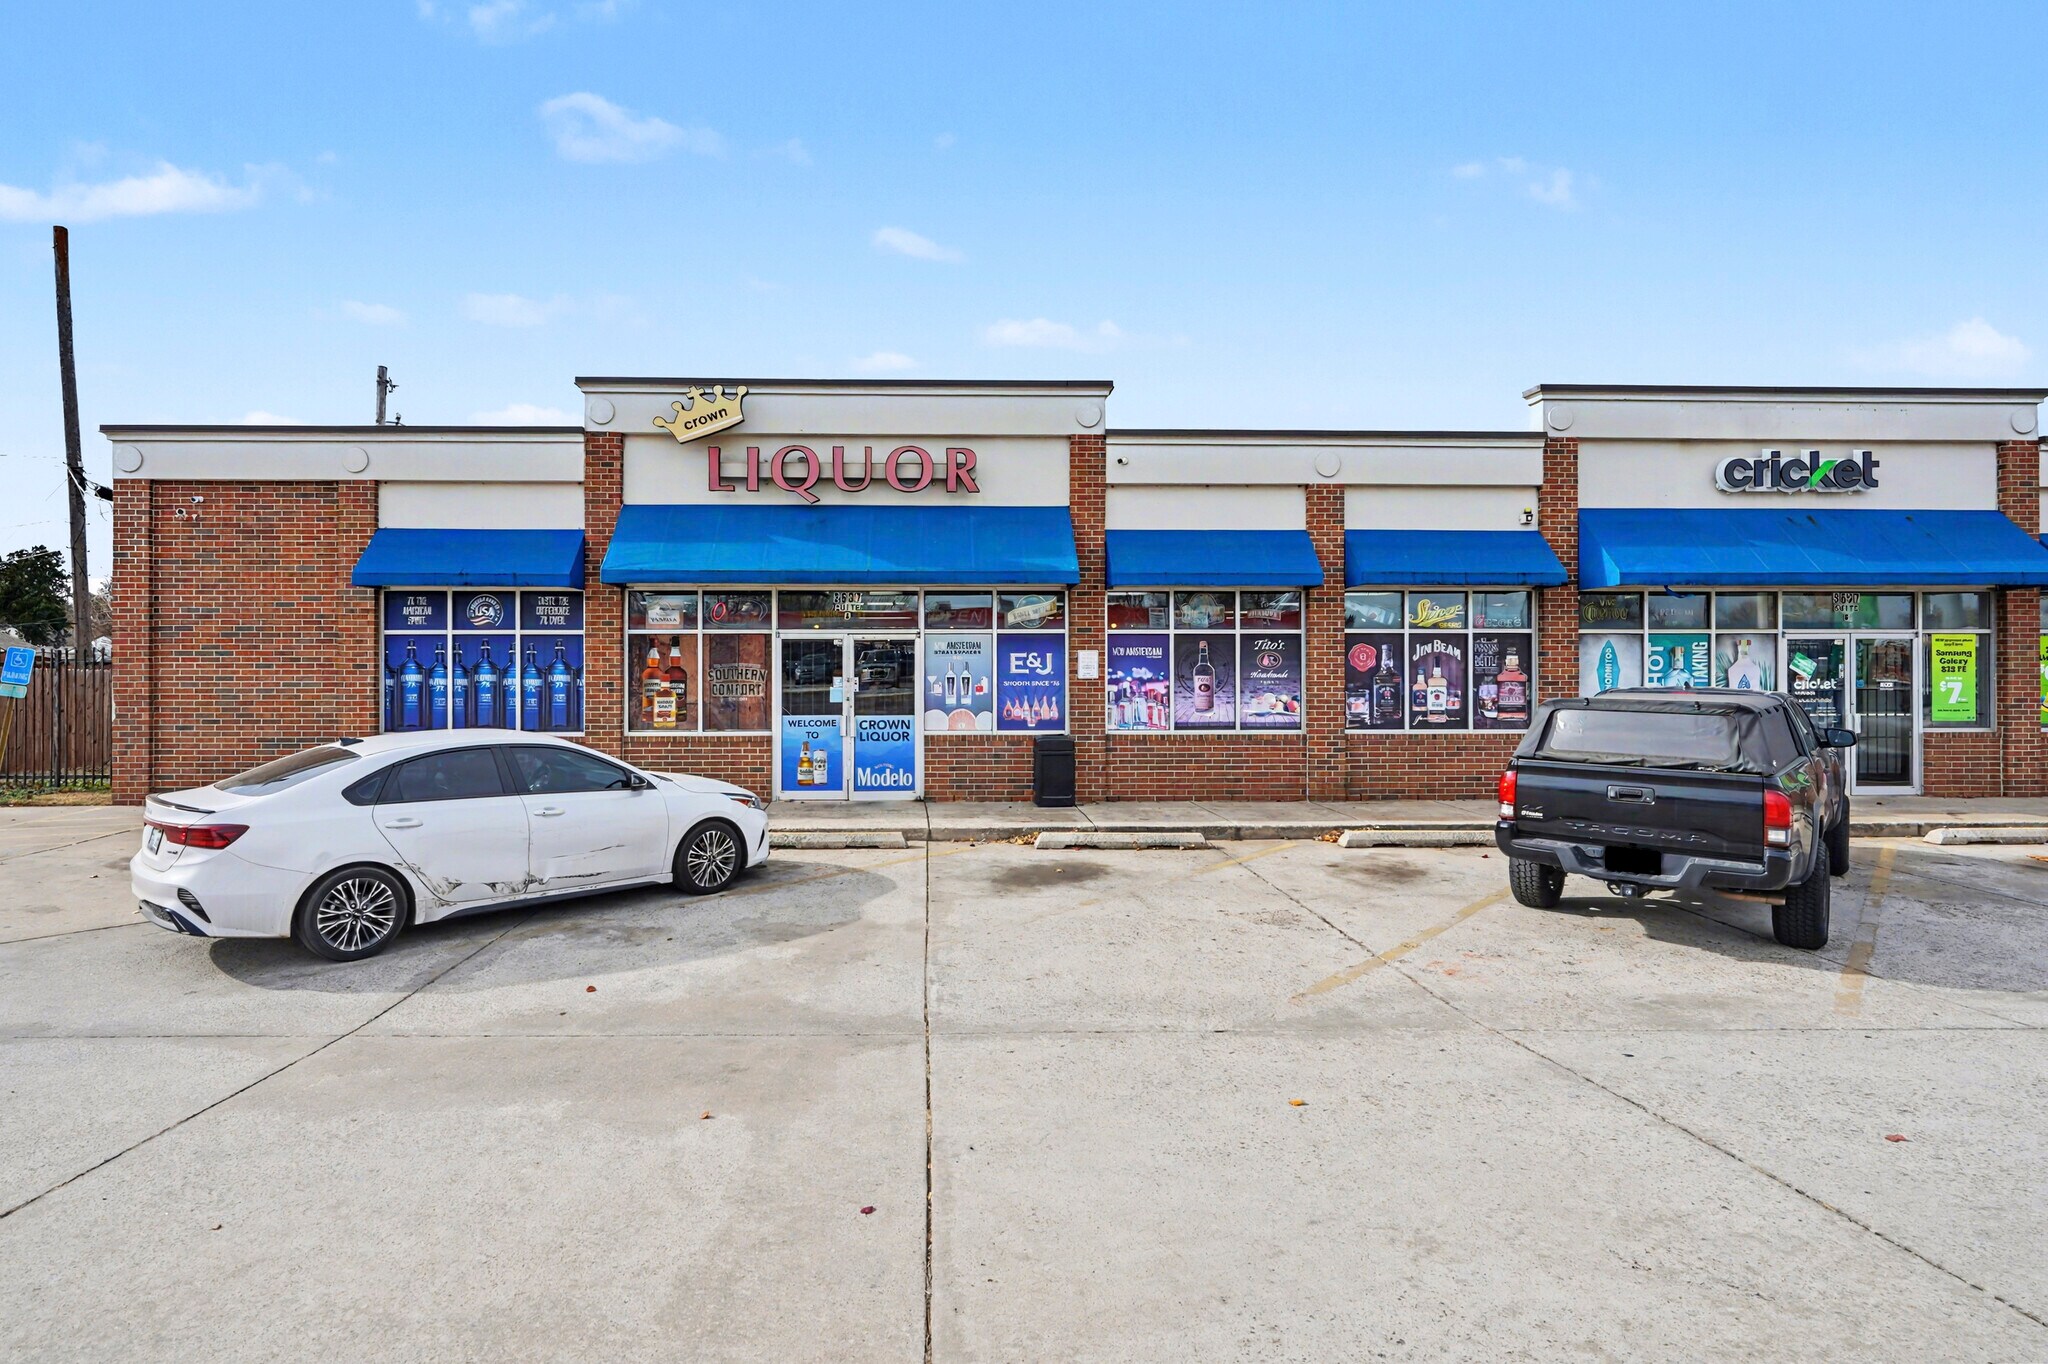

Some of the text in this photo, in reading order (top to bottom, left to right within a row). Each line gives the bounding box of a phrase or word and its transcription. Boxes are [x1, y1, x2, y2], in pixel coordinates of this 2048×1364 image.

[684, 407, 728, 431] crown
[708, 444, 980, 504] LIQUOR
[1722, 450, 1880, 489] cricket
[475, 606, 495, 616] USA
[1412, 642, 1432, 661] JIM
[1433, 639, 1461, 661] BEAM
[1935, 650, 1972, 658] Samsung
[1009, 652, 1053, 675] E&J
[708, 668, 768, 682] SOUTHERN
[712, 683, 762, 696] COMFORT
[788, 719, 837, 728] WELCOME
[859, 719, 911, 730] CROWN
[806, 731, 820, 739] TO
[859, 731, 910, 742] LIQUOR
[857, 767, 913, 787] Modelo
